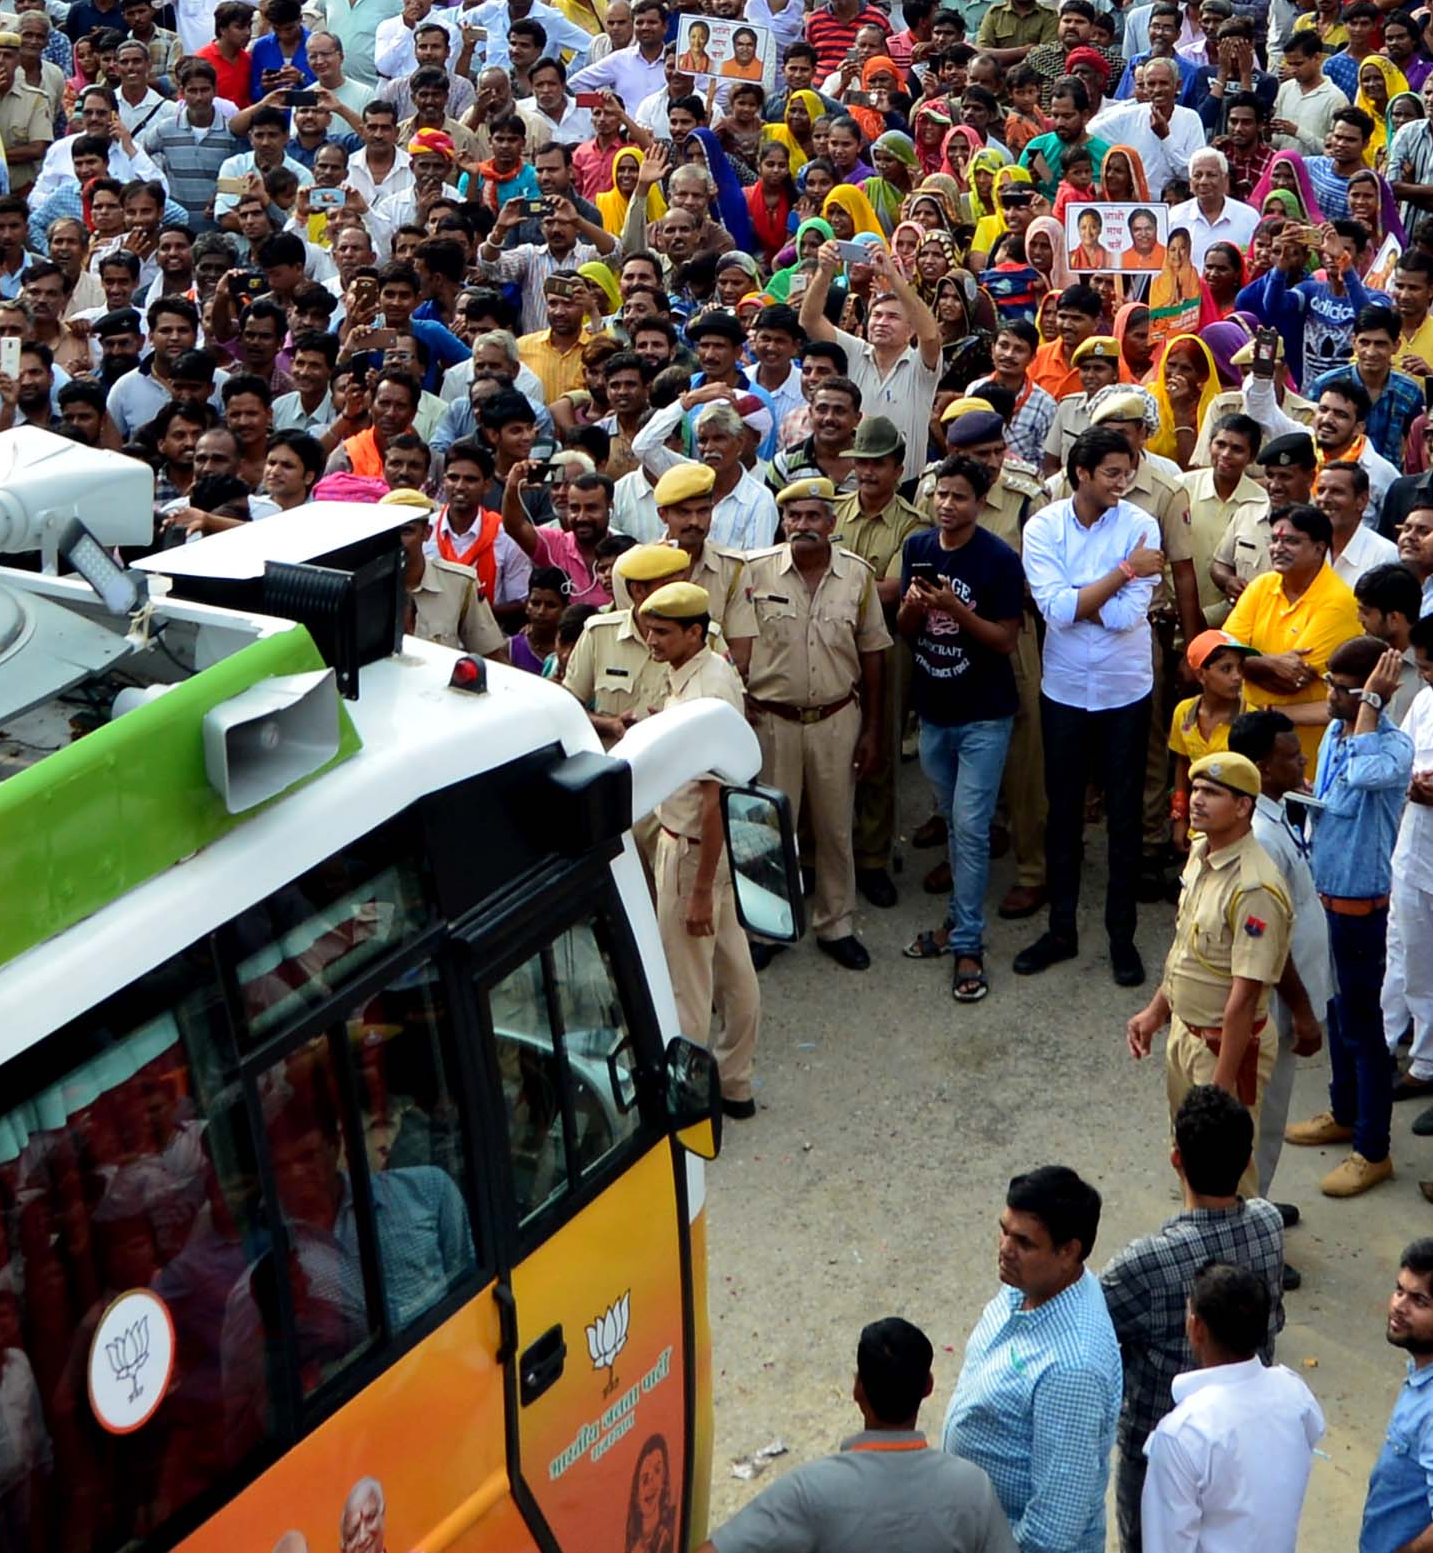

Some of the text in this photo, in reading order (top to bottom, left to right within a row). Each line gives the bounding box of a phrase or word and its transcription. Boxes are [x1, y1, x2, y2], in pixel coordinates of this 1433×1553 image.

[1310, 296, 1356, 321] adidas
[549, 1345, 674, 1481] भारतीय जनता पार्टी
